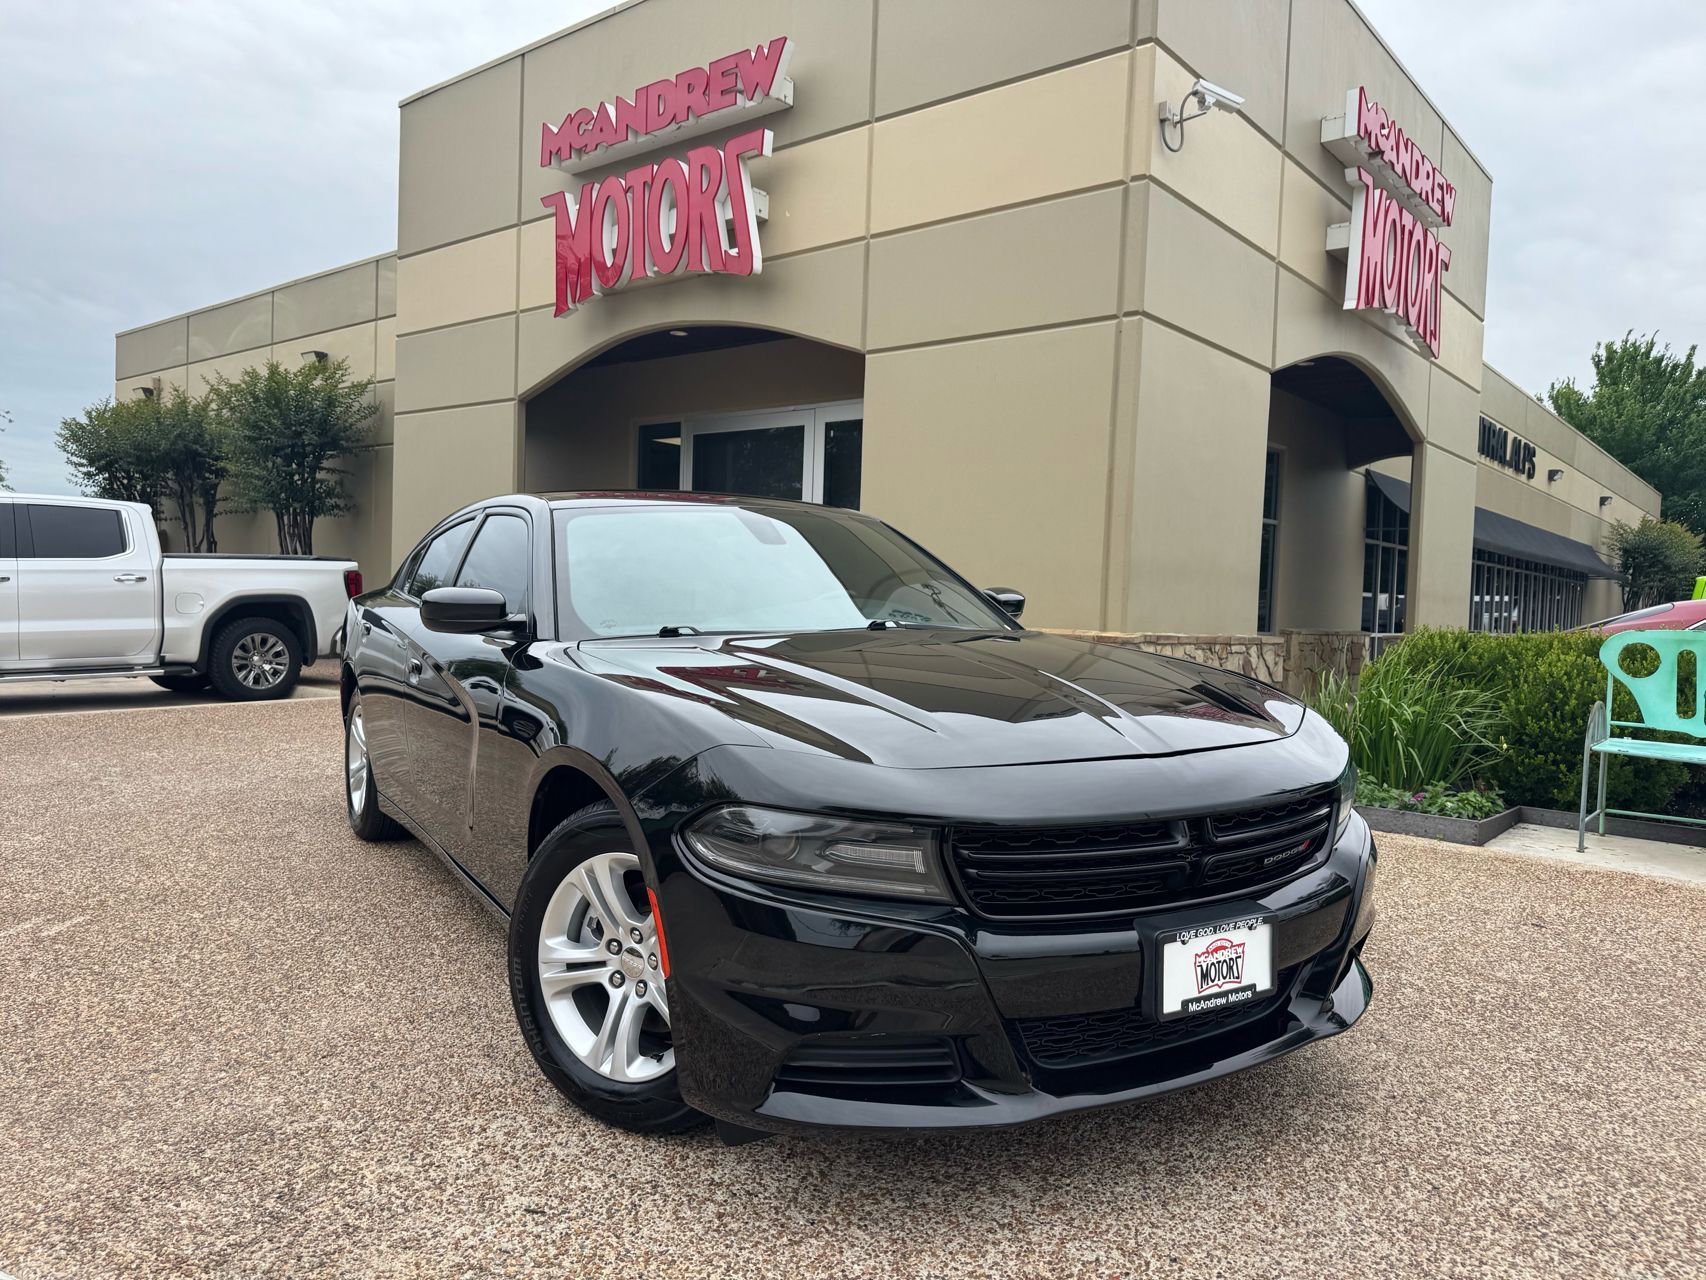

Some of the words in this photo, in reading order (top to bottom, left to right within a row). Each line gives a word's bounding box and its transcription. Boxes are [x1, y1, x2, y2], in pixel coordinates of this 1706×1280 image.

[540, 128, 766, 318] MOTORS
[1355, 165, 1452, 359] MOTORS
[1176, 930, 1196, 942] LOVE
[1197, 927, 1215, 937] GOD.
[1216, 922, 1235, 933] LOVE
[1197, 955, 1242, 989] MOTORS
[1188, 996, 1227, 1012] McAndrew
[1228, 990, 1252, 1003] Motors
